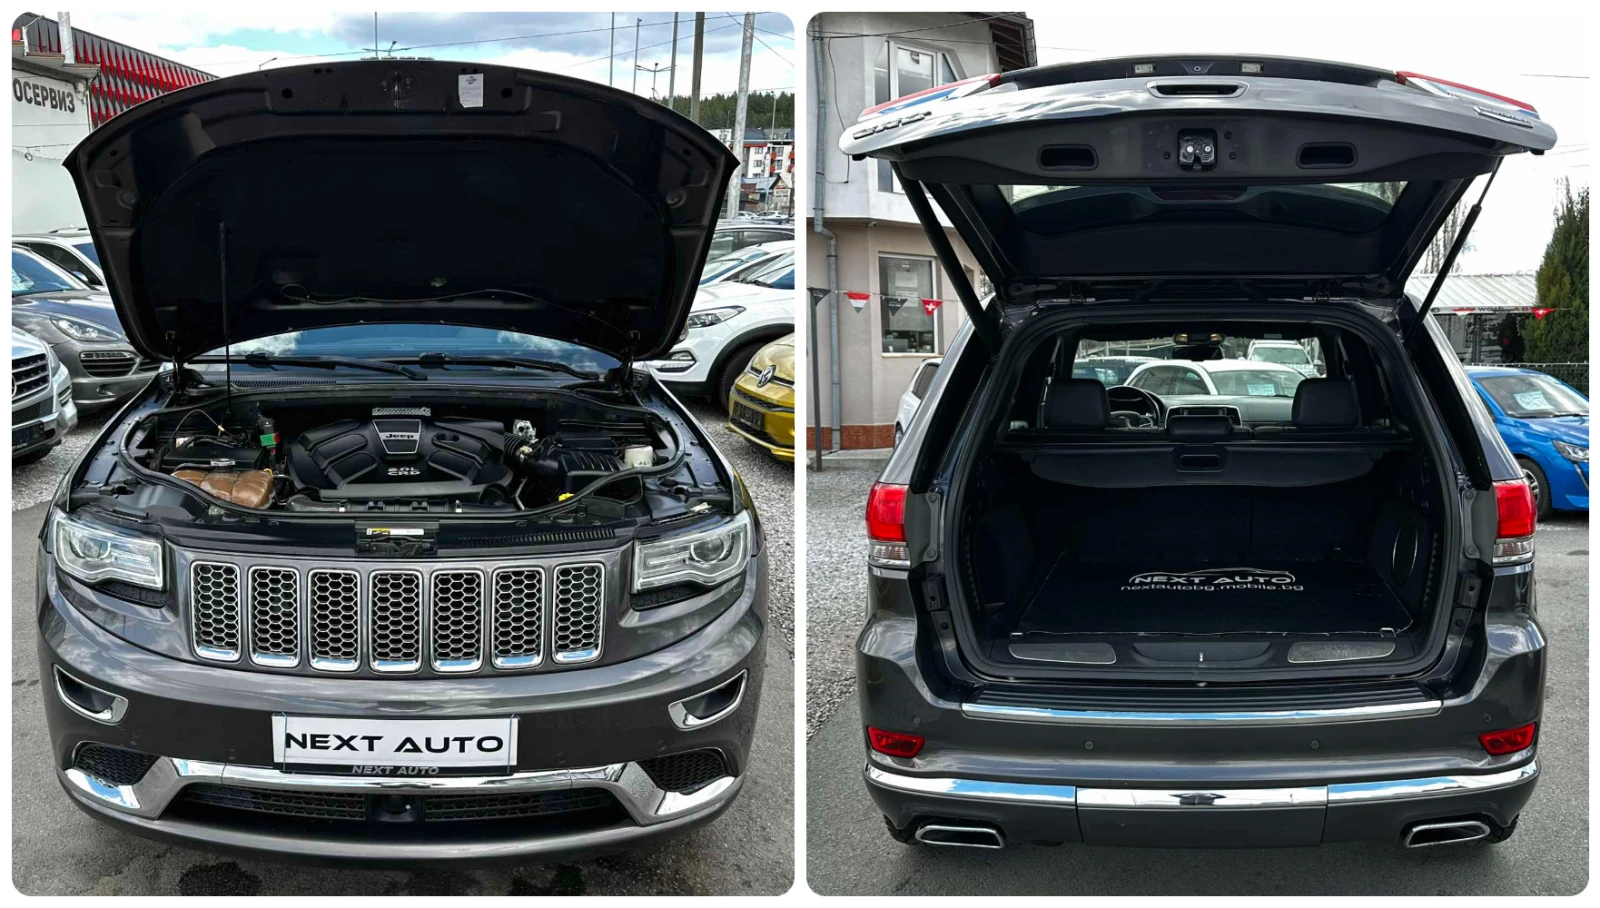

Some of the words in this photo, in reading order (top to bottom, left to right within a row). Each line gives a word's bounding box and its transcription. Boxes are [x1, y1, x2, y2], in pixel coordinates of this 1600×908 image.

[12, 78, 75, 113] ОСЕРВИЗ
[1134, 576, 1206, 584] NEXT
[1212, 576, 1291, 584] AUTO
[1120, 583, 1304, 591] nextautobg.mobile.bg
[285, 732, 384, 751] NEXT
[393, 735, 504, 753] AUTO
[351, 765, 394, 775] NEXT
[396, 766, 440, 775] AUTO
